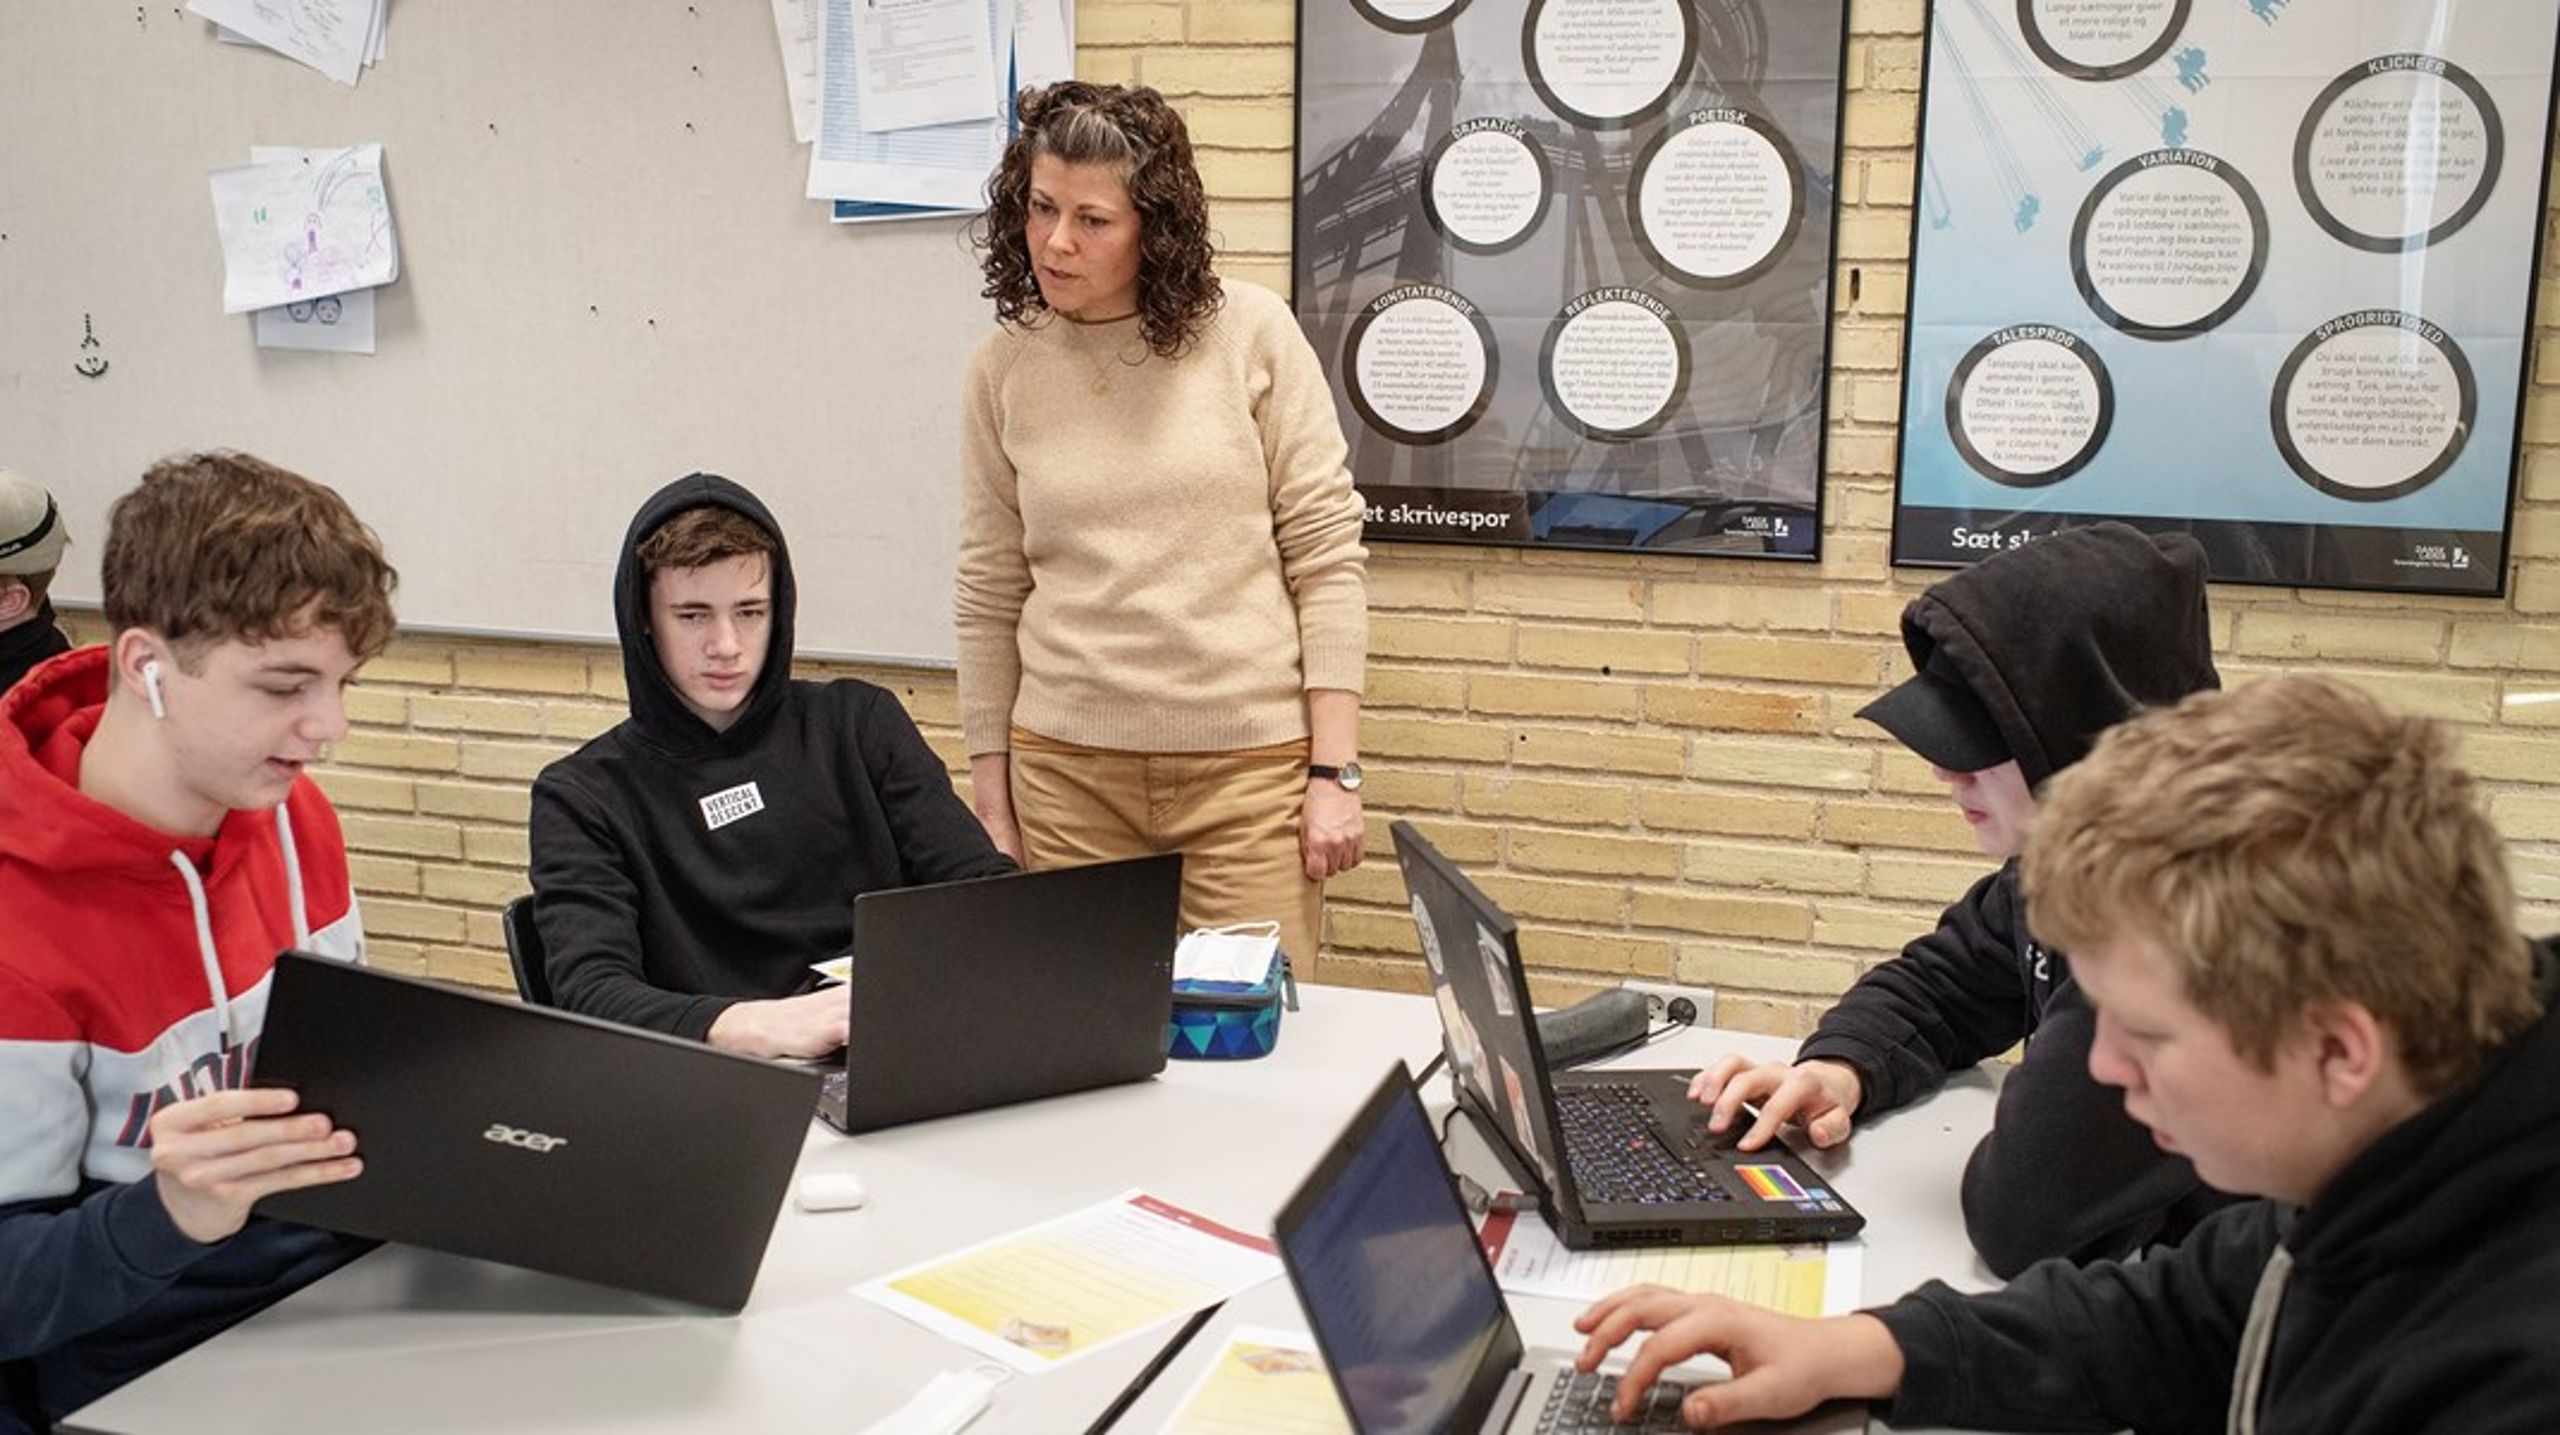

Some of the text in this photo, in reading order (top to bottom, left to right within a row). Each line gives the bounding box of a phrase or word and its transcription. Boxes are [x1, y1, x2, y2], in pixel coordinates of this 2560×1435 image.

[2368, 56, 2446, 75] KLICHEER
[1689, 109, 1748, 125] POETISK
[2138, 149, 2218, 170] VARIATION
[1372, 286, 1475, 316] KONSTATERENDE
[1564, 288, 1671, 320] REFLEKTERENDE
[1993, 327, 2075, 347] TALESPROG
[2315, 312, 2444, 343] SPROGRIGTIGHED
[1389, 503, 1510, 532] skrivespor
[1952, 527, 2002, 549] Sæt
[706, 788, 754, 813] VERTICAL
[711, 798, 757, 826] DESCENT
[483, 1123, 568, 1153] acer
